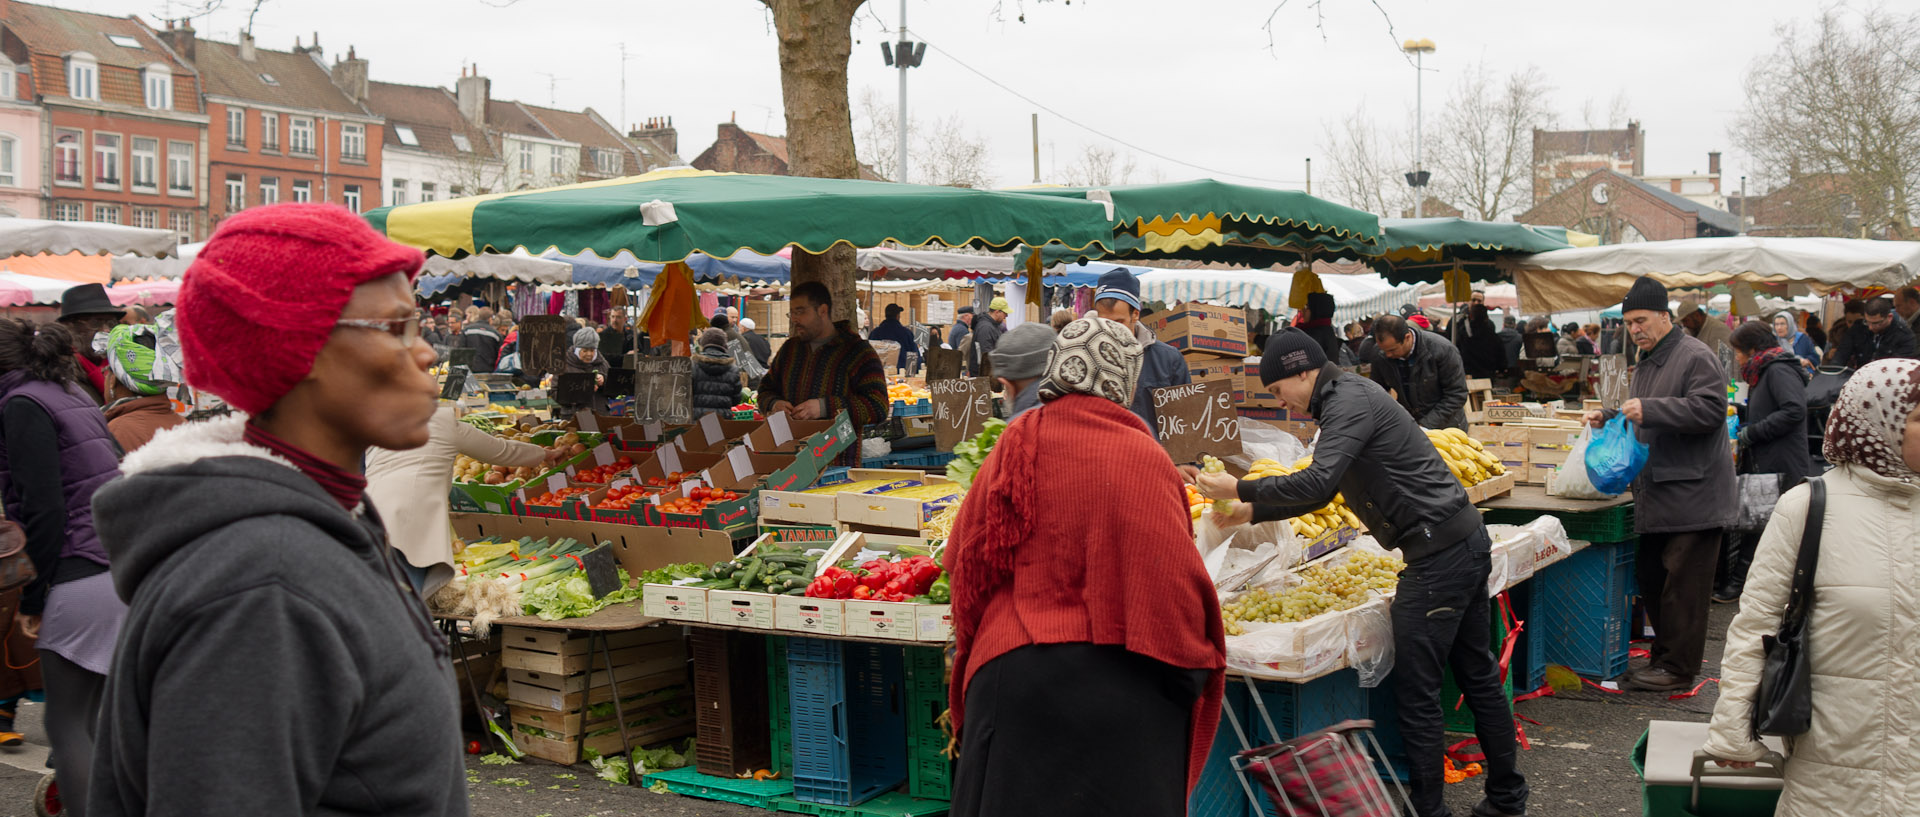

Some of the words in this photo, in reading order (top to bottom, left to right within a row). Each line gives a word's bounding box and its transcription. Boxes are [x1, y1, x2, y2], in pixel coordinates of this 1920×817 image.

[1193, 337, 1220, 348] BANANAS
[1154, 383, 1206, 408] BANANE
[779, 529, 835, 542] YAMAMA
[1535, 544, 1558, 562] LEON
